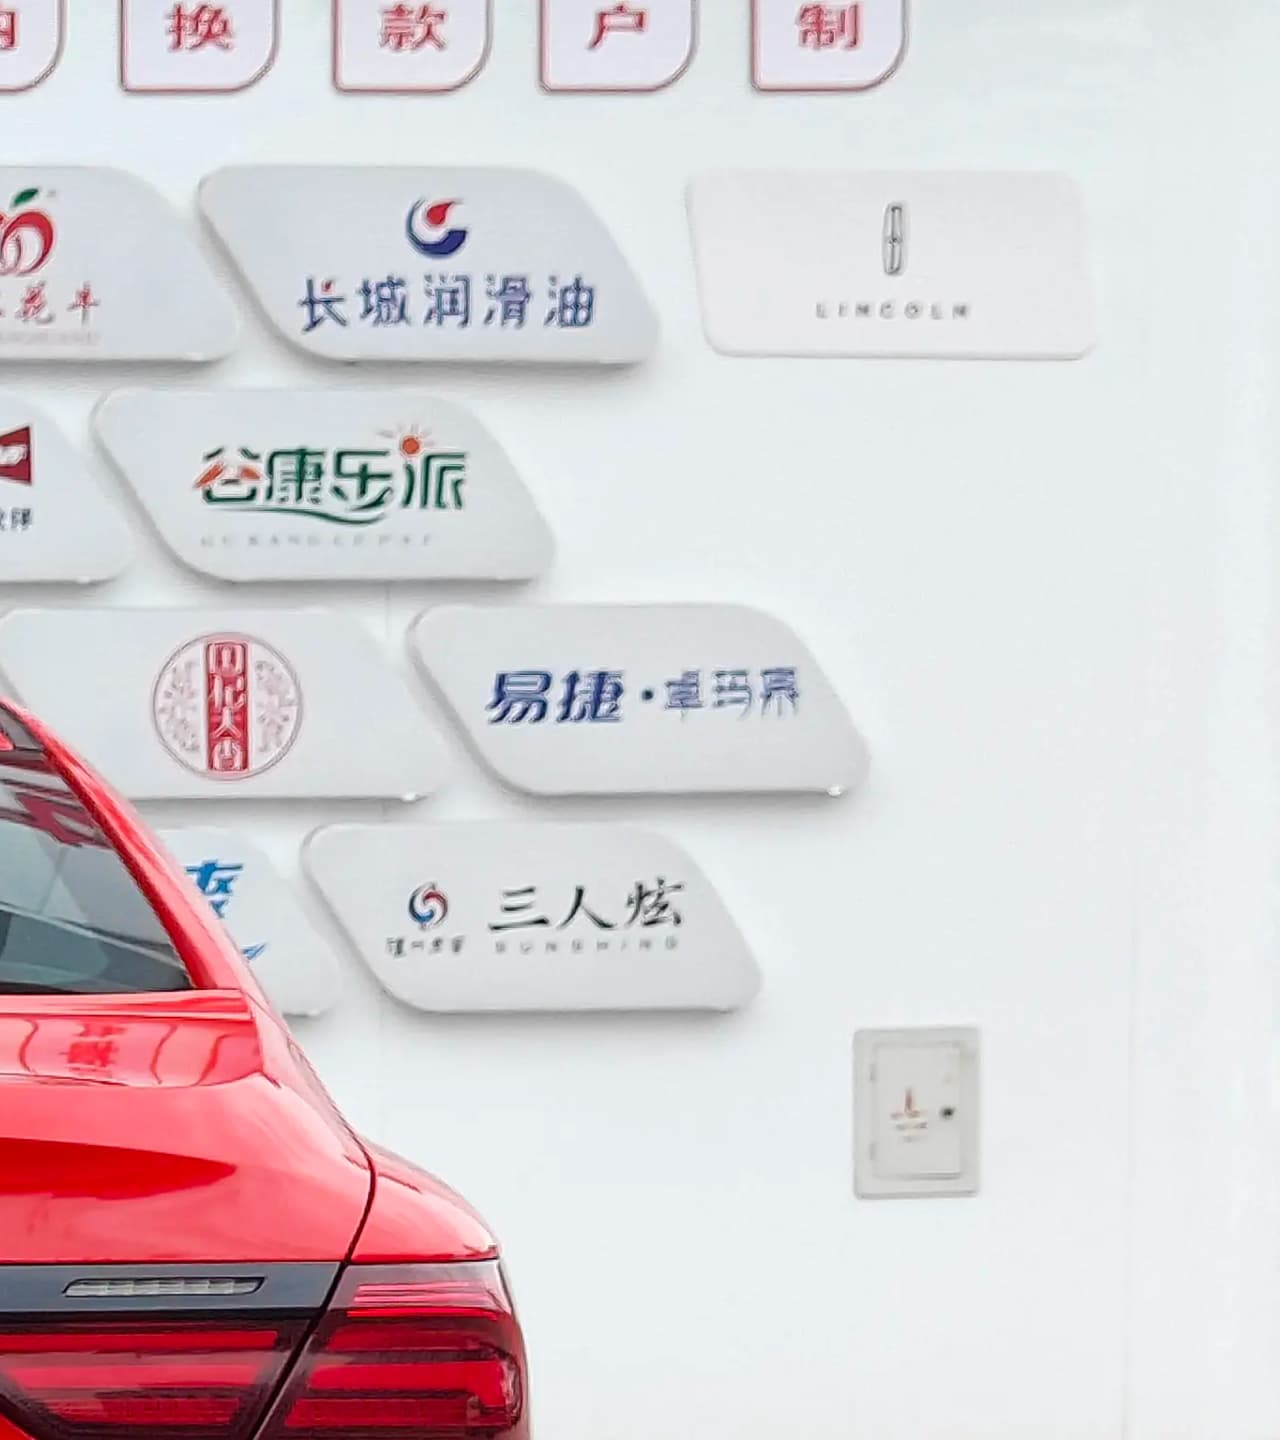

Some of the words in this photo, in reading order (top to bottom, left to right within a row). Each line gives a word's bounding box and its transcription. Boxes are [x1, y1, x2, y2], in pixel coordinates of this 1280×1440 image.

[169, 4, 232, 50] 换
[382, 3, 446, 51] 款
[588, 3, 647, 50] 户
[798, 3, 861, 50] 制
[298, 274, 595, 333] 长城润滑油
[815, 301, 970, 320] LINCOLN
[194, 443, 467, 510] 谷康乐派
[488, 876, 686, 931] 三人炫
